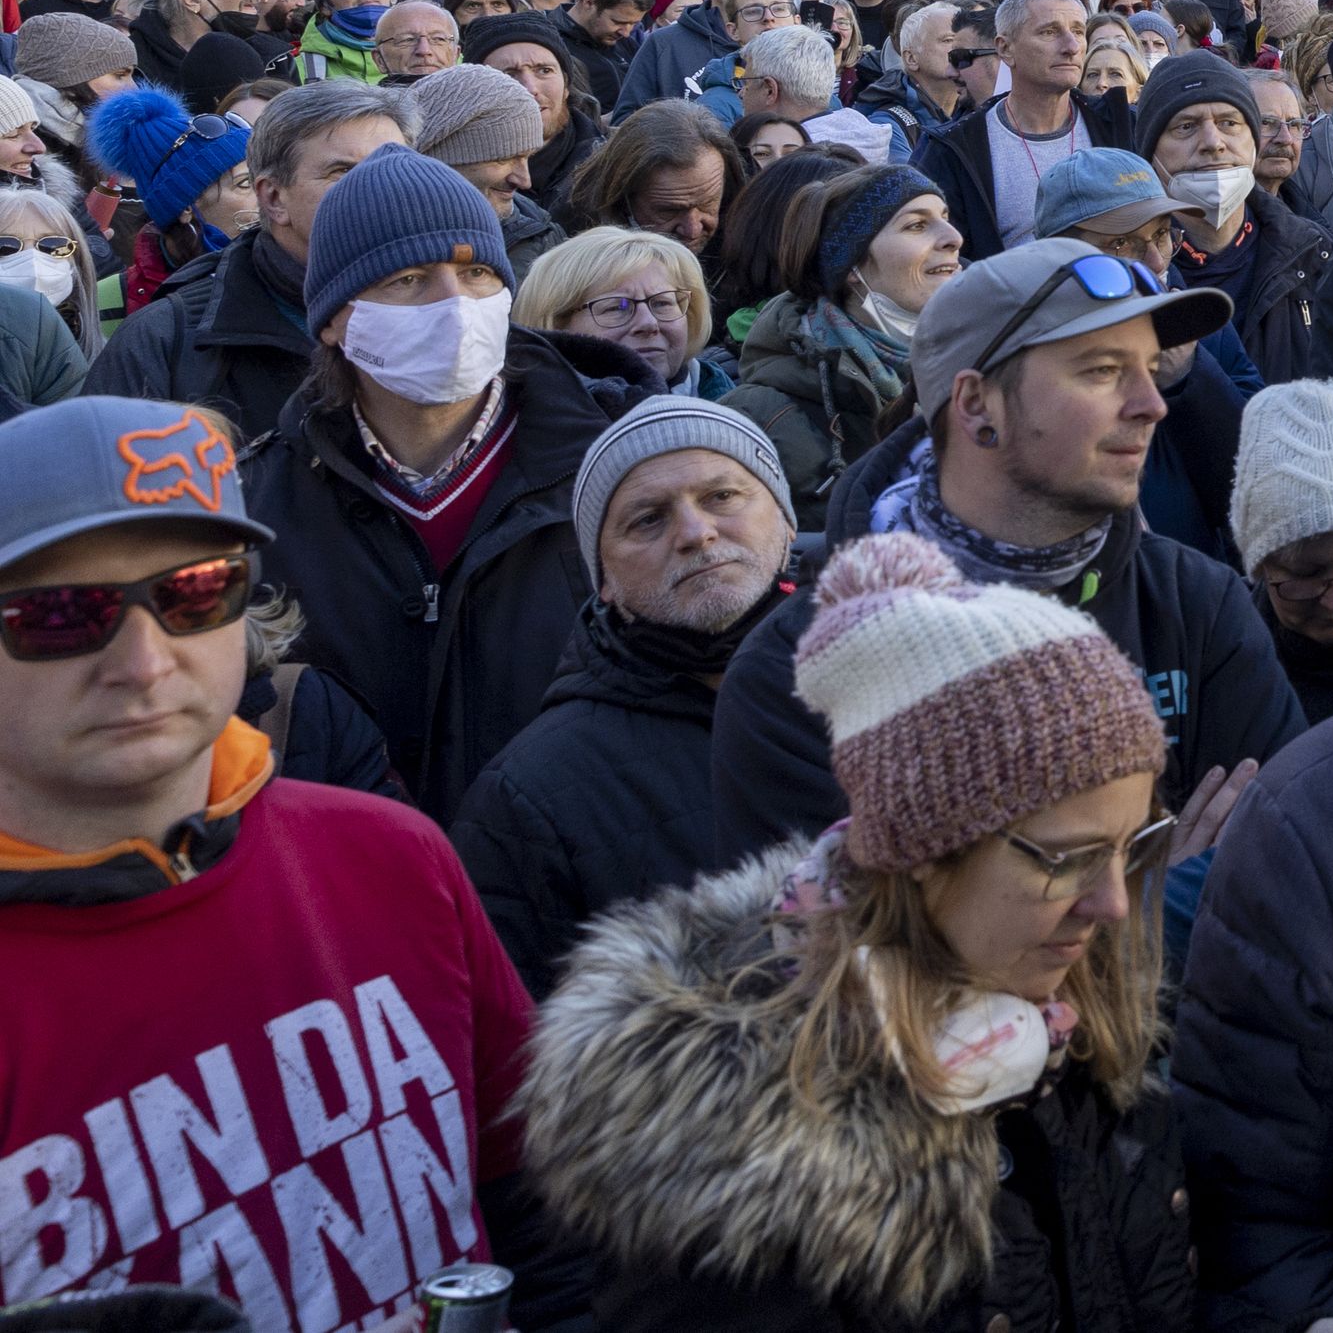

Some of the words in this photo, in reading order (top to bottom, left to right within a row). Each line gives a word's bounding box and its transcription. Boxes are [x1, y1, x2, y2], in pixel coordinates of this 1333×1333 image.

[0, 1044, 271, 1306] BIN
[264, 974, 456, 1158] DA
[86, 1089, 478, 1333] ANN
